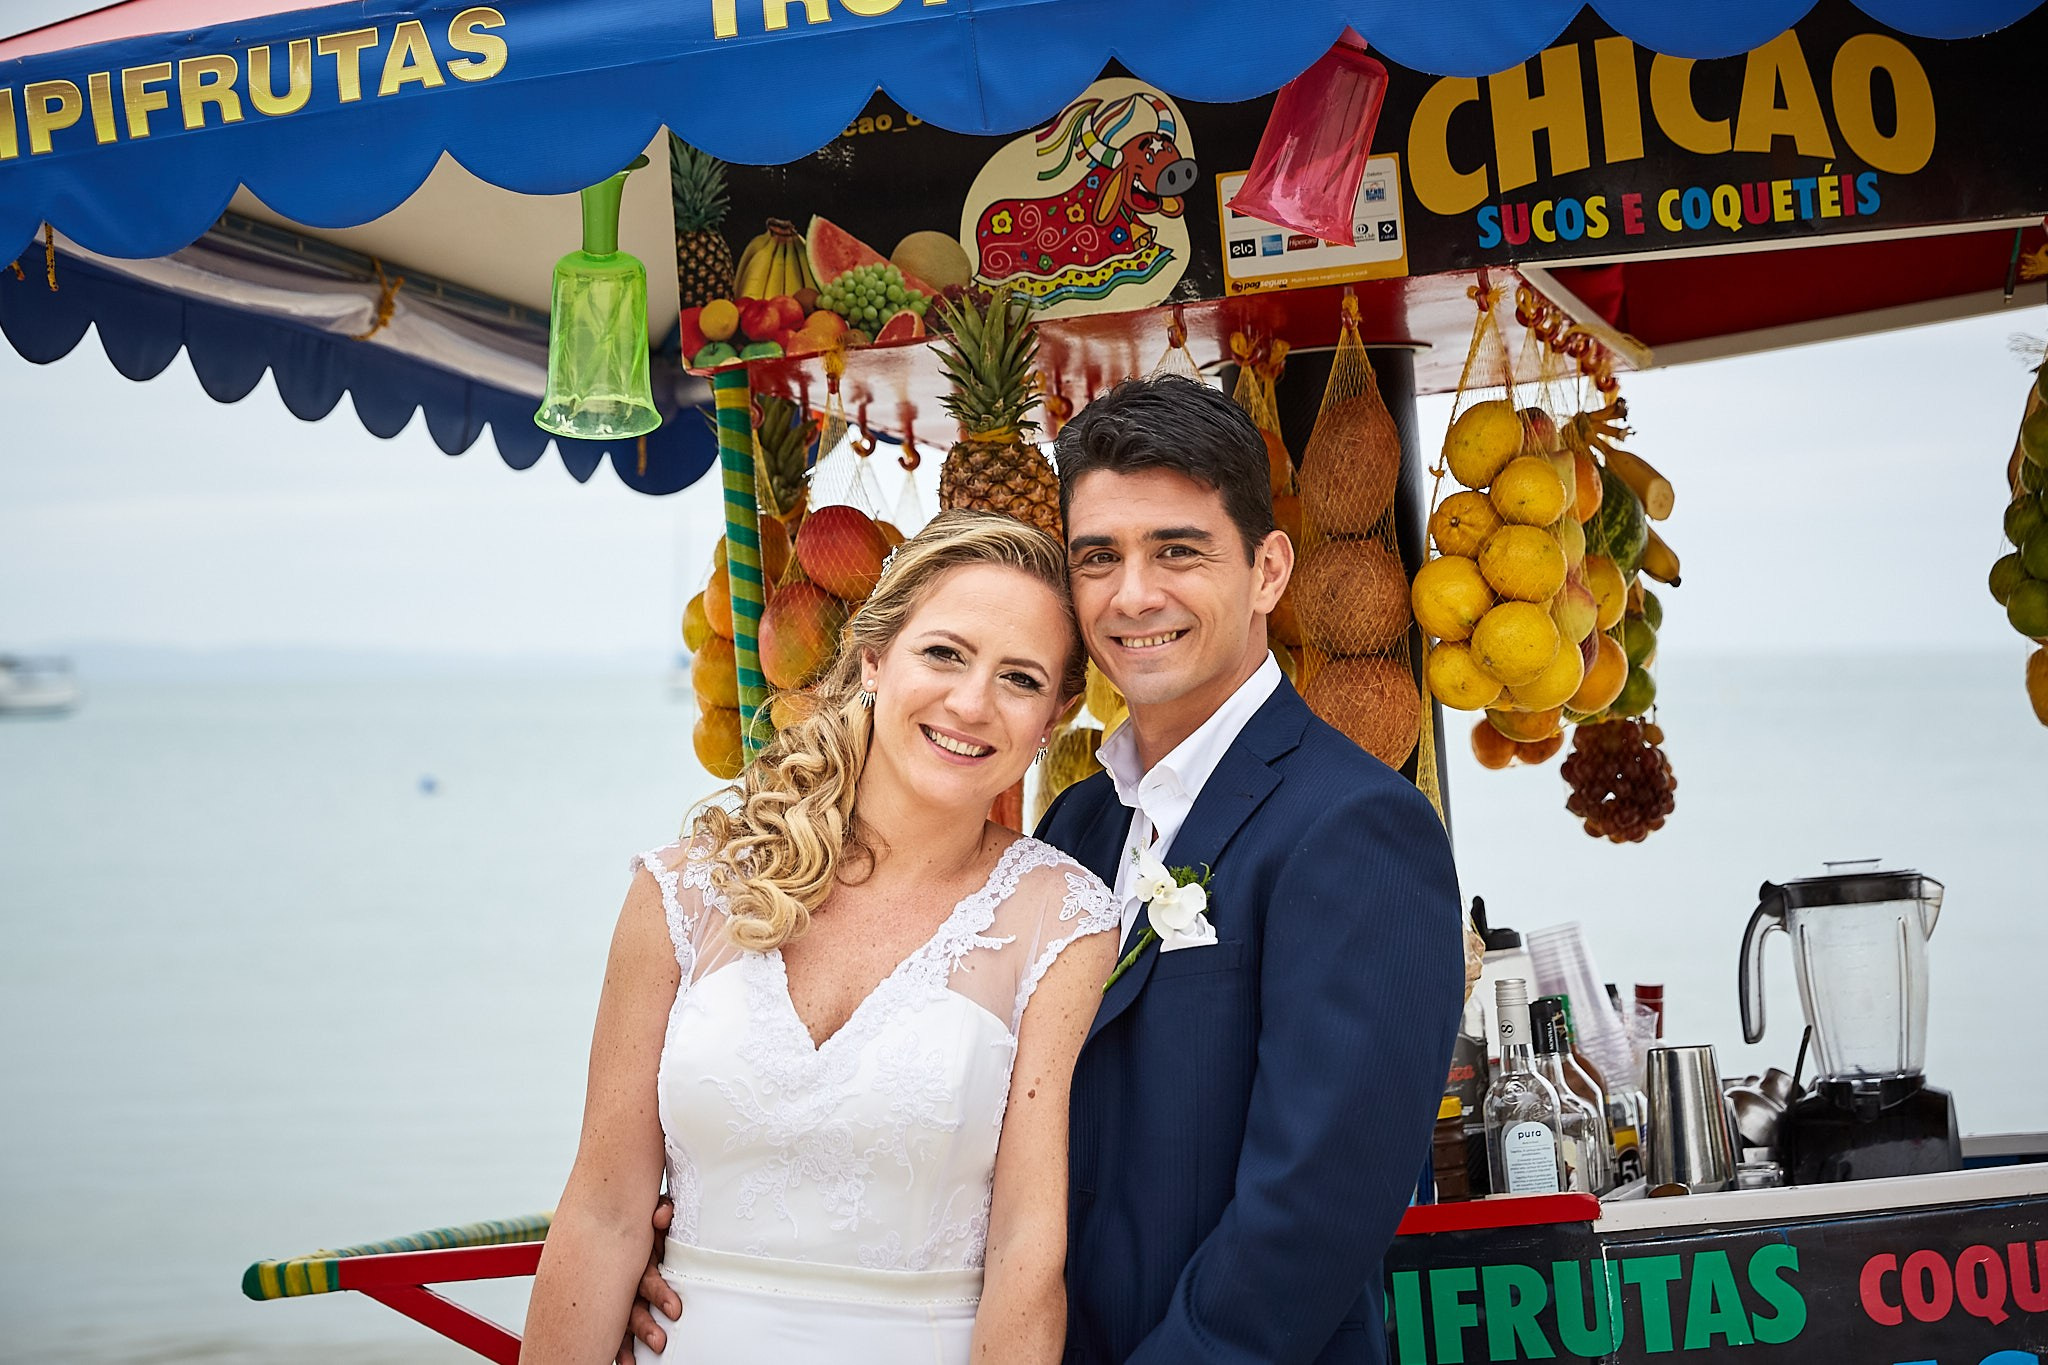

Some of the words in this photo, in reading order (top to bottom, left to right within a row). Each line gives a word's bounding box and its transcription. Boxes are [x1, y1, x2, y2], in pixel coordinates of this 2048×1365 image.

[1477, 196, 1610, 249] SUCOS
[1622, 192, 1645, 236] E
[1658, 162, 1881, 232] COQUETÉIS
[1232, 242, 1254, 255] elo
[1288, 238, 1318, 248] Hipercard
[1243, 279, 1288, 290] pagseguro
[1517, 1130, 1542, 1140] pura
[1859, 1240, 2048, 1326] COQU
[1384, 1244, 1808, 1365] IFRUTAS
